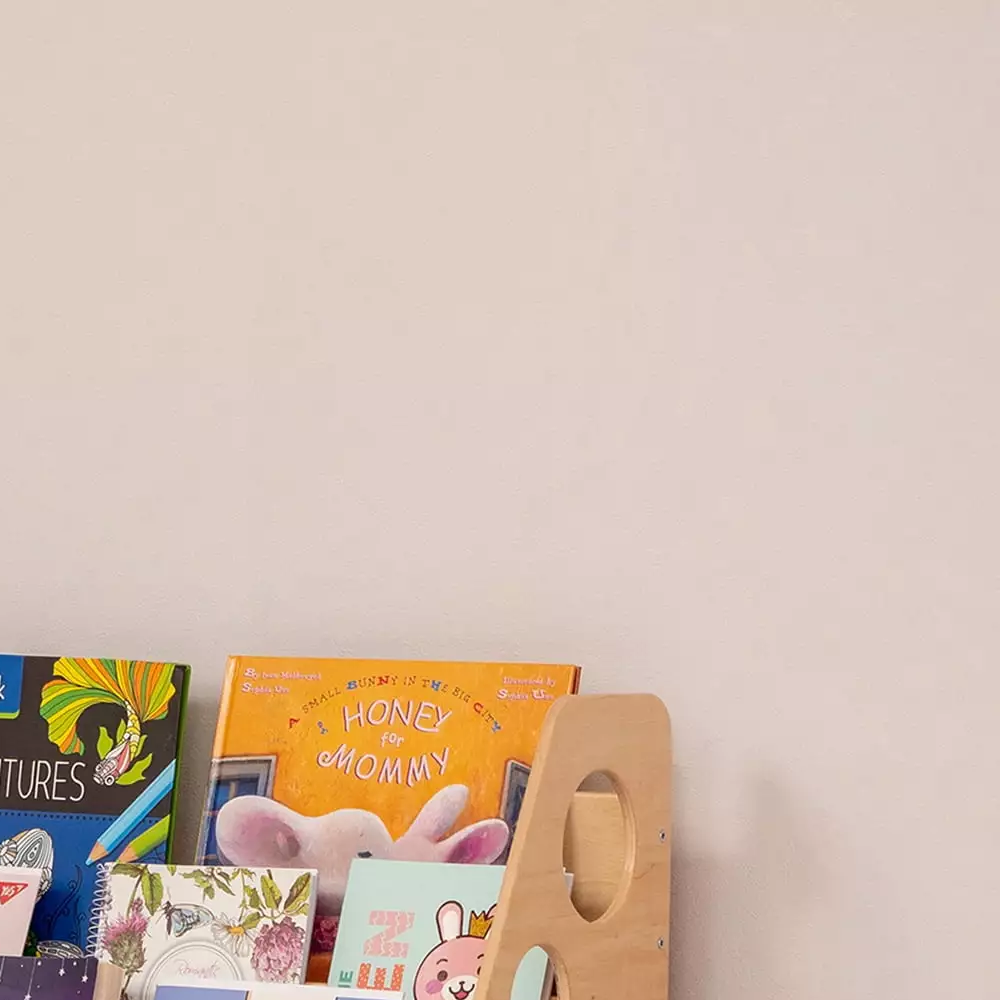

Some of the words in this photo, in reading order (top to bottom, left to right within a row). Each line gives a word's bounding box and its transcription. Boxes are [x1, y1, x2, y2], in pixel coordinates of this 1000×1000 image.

[289, 718, 300, 729] A
[301, 687, 342, 714] SMALL
[347, 675, 398, 691] BUNNY
[403, 675, 416, 686] IN
[421, 679, 448, 693] THE
[451, 686, 471, 704] BIG
[473, 702, 501, 733] CITY
[342, 698, 452, 733] HONEY
[380, 732, 404, 749] for
[315, 743, 450, 788] MOMMY
